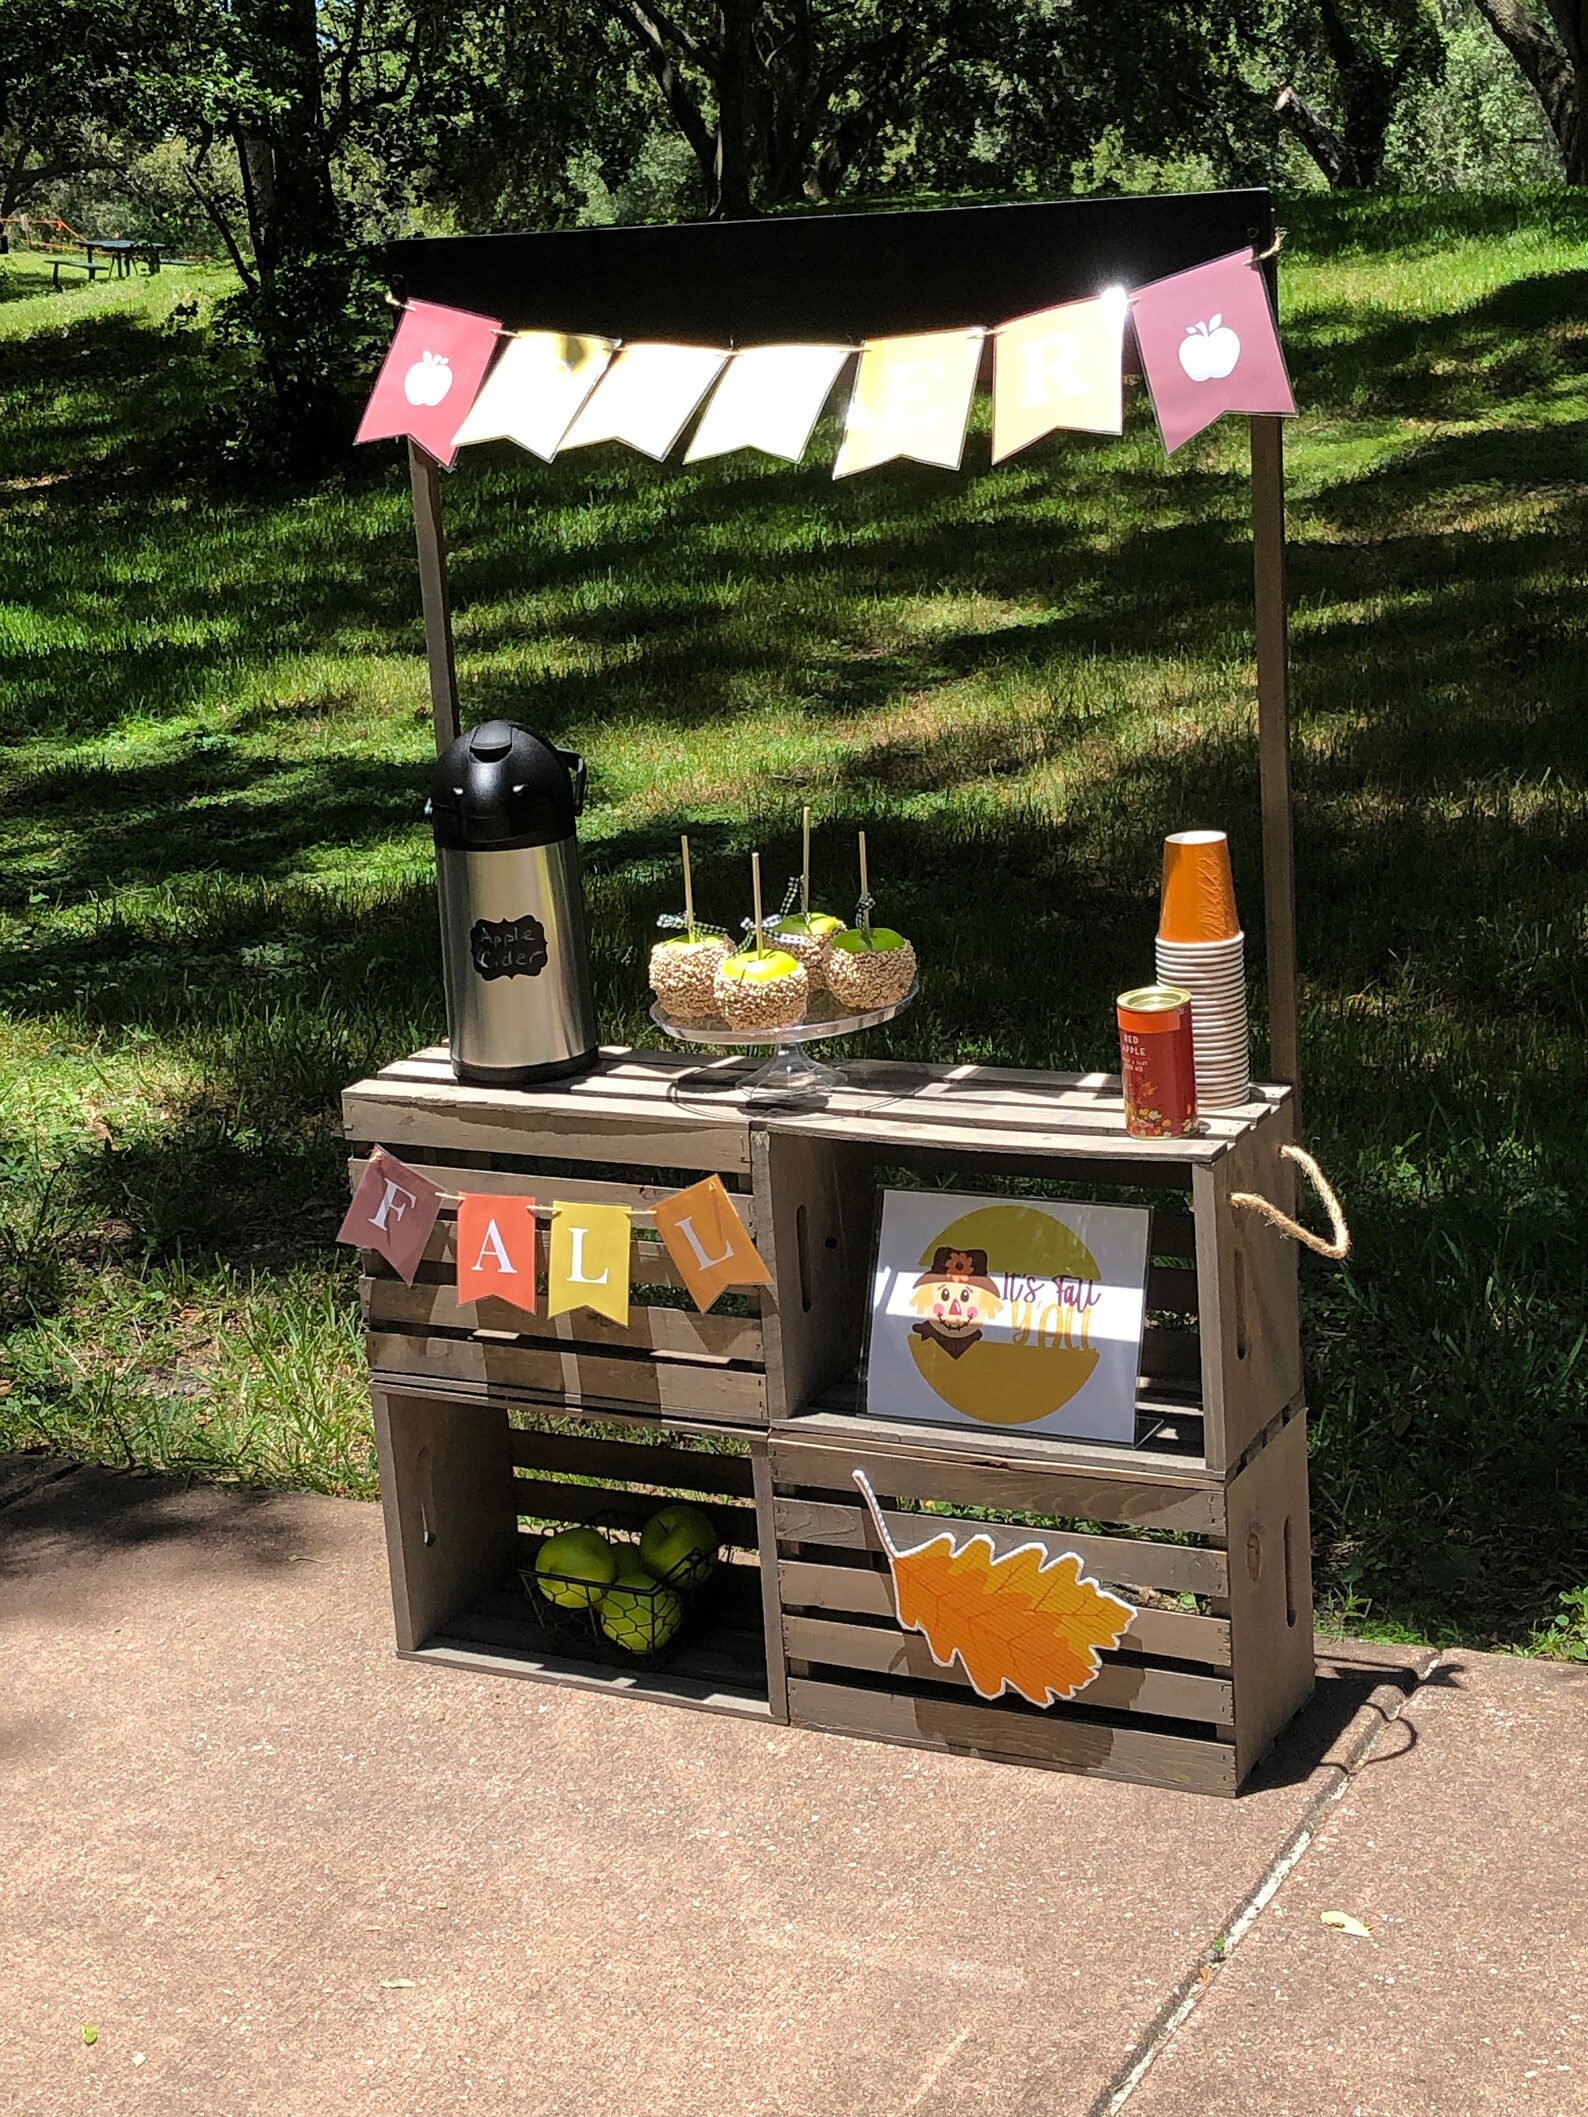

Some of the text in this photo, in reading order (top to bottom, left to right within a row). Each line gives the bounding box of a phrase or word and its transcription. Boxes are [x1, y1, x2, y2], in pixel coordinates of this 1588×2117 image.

[480, 926, 536, 948] Apple
[1123, 1033, 1139, 1044] RED
[1122, 1045, 1146, 1056] APPLE
[368, 1178, 735, 1285] FALL
[1002, 1272, 1102, 1313] It's Fall
